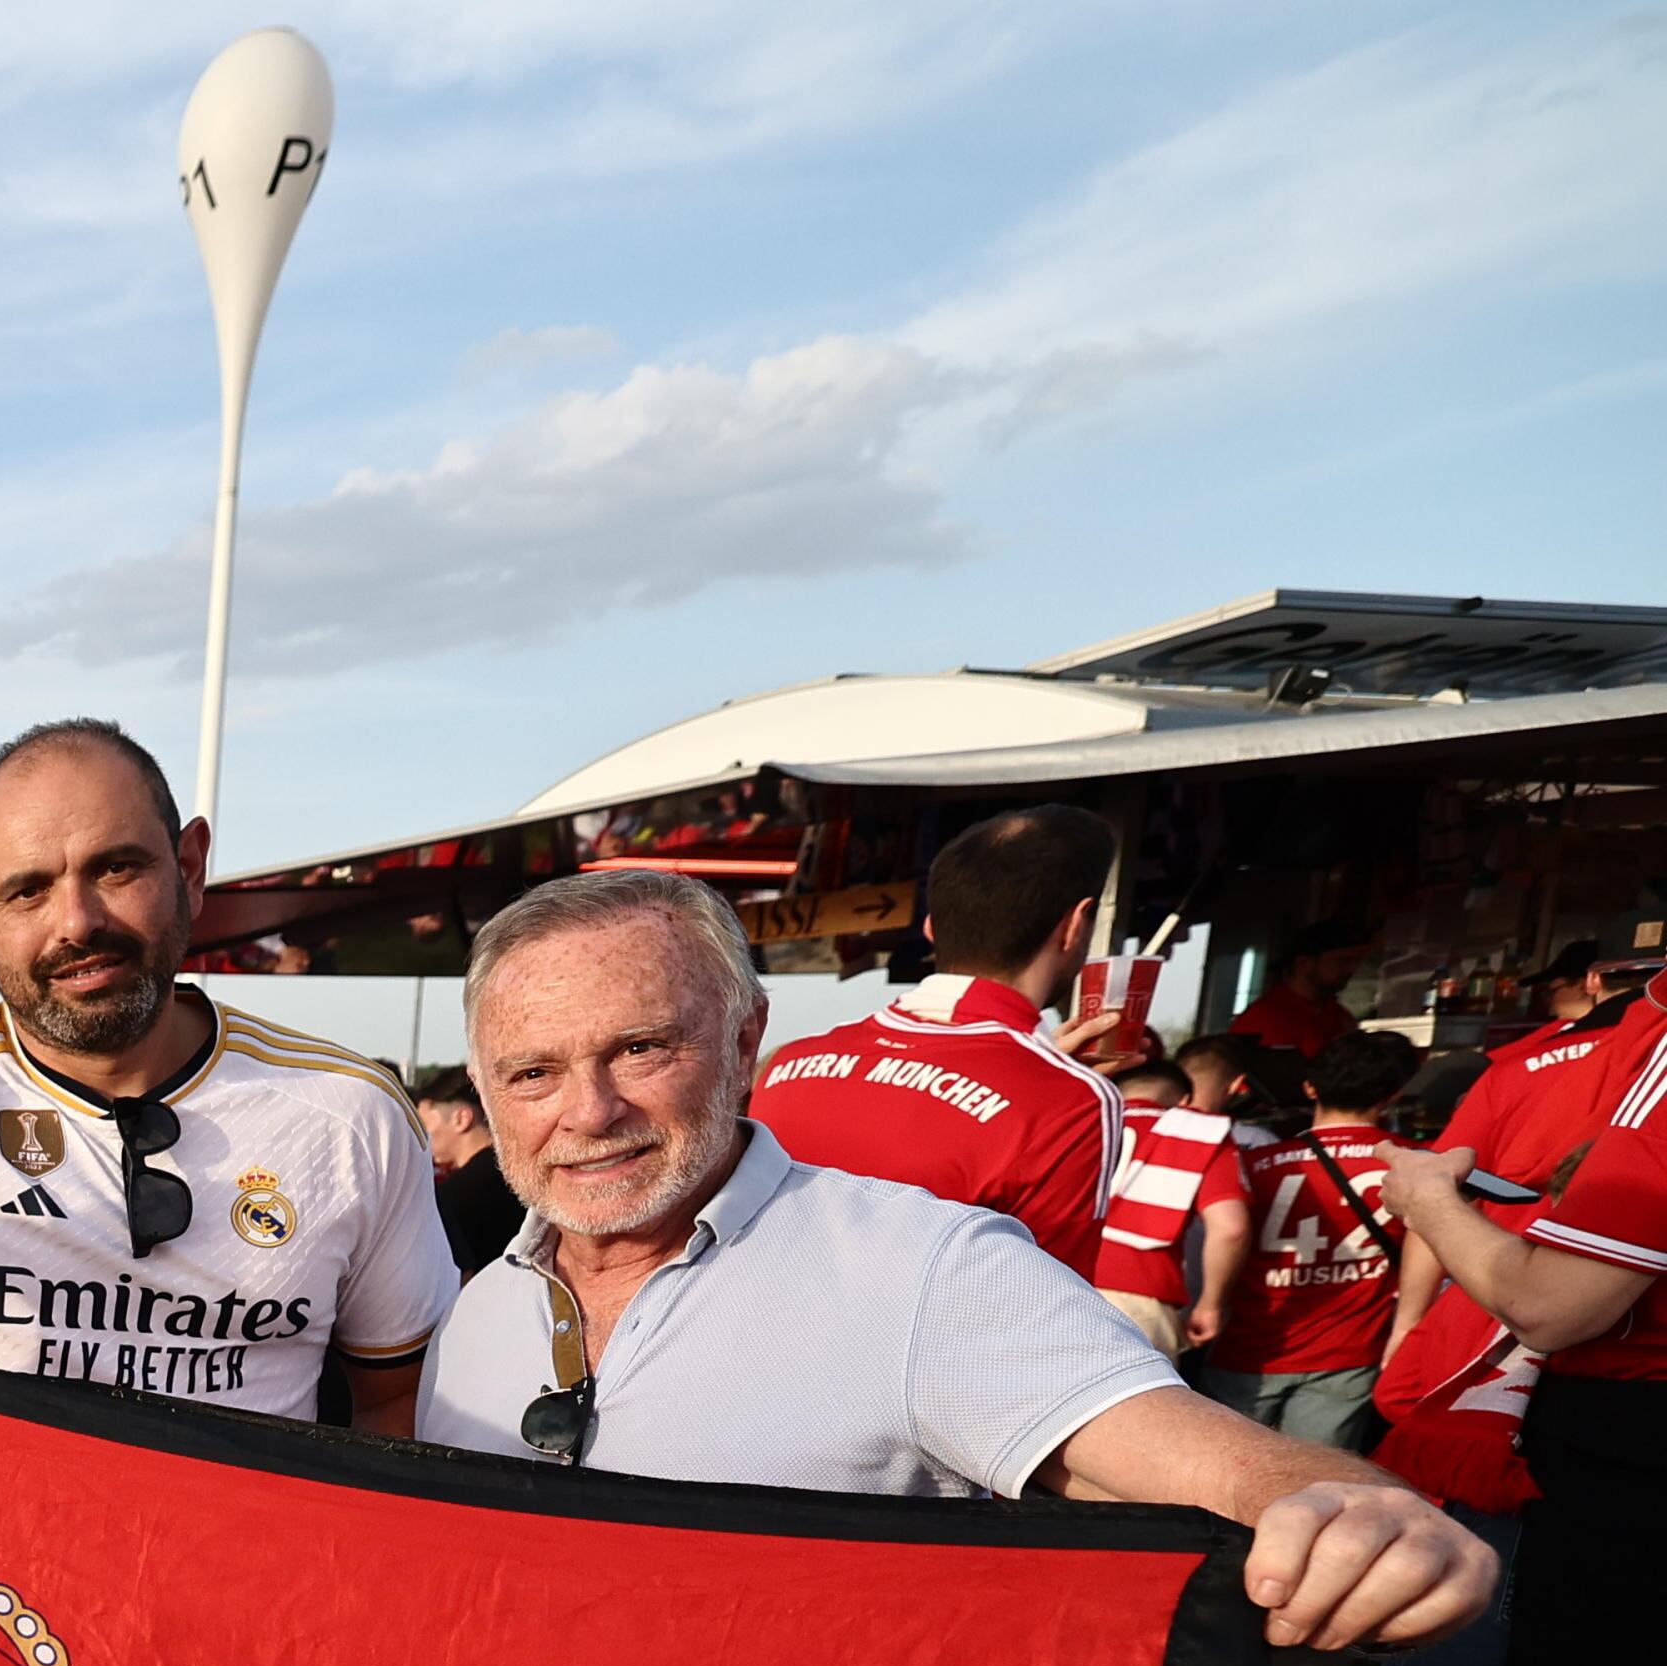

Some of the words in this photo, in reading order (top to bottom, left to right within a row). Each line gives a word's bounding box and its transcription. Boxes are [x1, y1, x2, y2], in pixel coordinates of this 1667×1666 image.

[1525, 1041, 1597, 1072] BAYER
[764, 1053, 860, 1088] BAYERN
[865, 1057, 1011, 1123] MÜNCHEN
[18, 1152, 48, 1161] FIFA
[1273, 1145, 1336, 1166] BAYEN
[117, 1344, 248, 1394] BETTER
